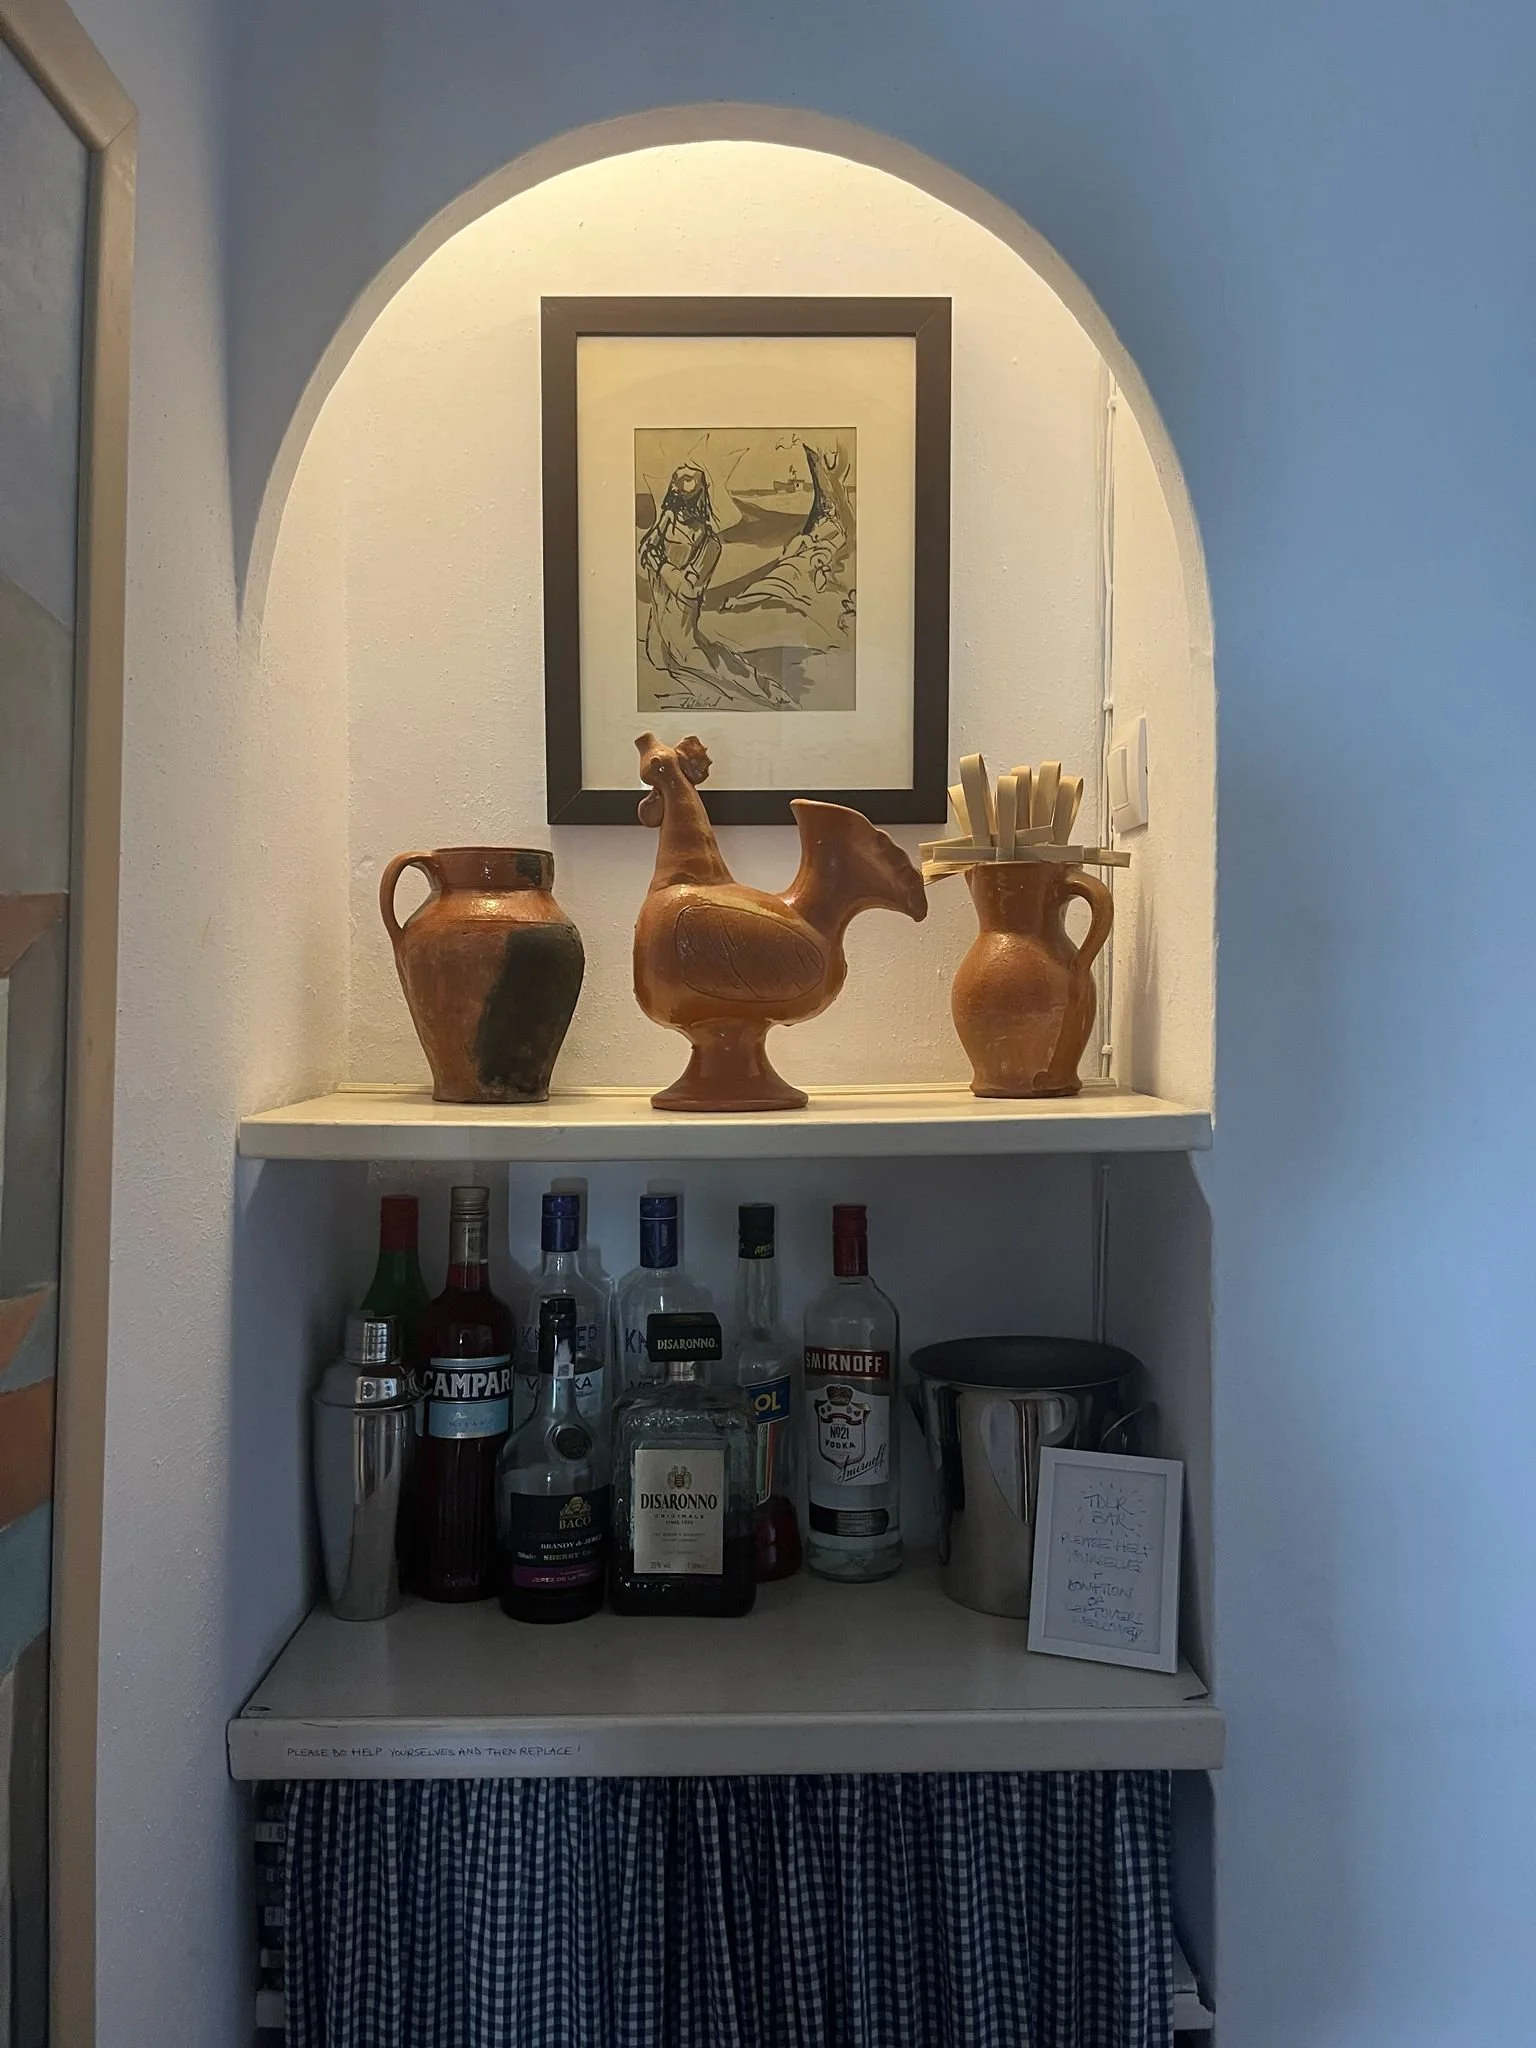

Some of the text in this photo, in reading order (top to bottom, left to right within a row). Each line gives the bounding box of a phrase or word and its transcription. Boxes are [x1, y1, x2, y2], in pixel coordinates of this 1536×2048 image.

[656, 1337, 716, 1351] DISARONNO
[805, 1352, 883, 1373] SMIRNOFF
[423, 1365, 514, 1398] CAMPARI
[825, 1439, 856, 1449] VODKA
[640, 1493, 717, 1510] DISARONNO
[559, 1515, 592, 1530] BACO
[1091, 1511, 1135, 1531] BAR
[540, 1541, 575, 1550] BRANDY
[287, 1747, 329, 1757] PLEASE
[332, 1747, 348, 1757] DO
[351, 1746, 383, 1757] HELP
[388, 1746, 456, 1757] YOURSELVES
[458, 1746, 482, 1757] AND
[486, 1746, 517, 1756] THEN
